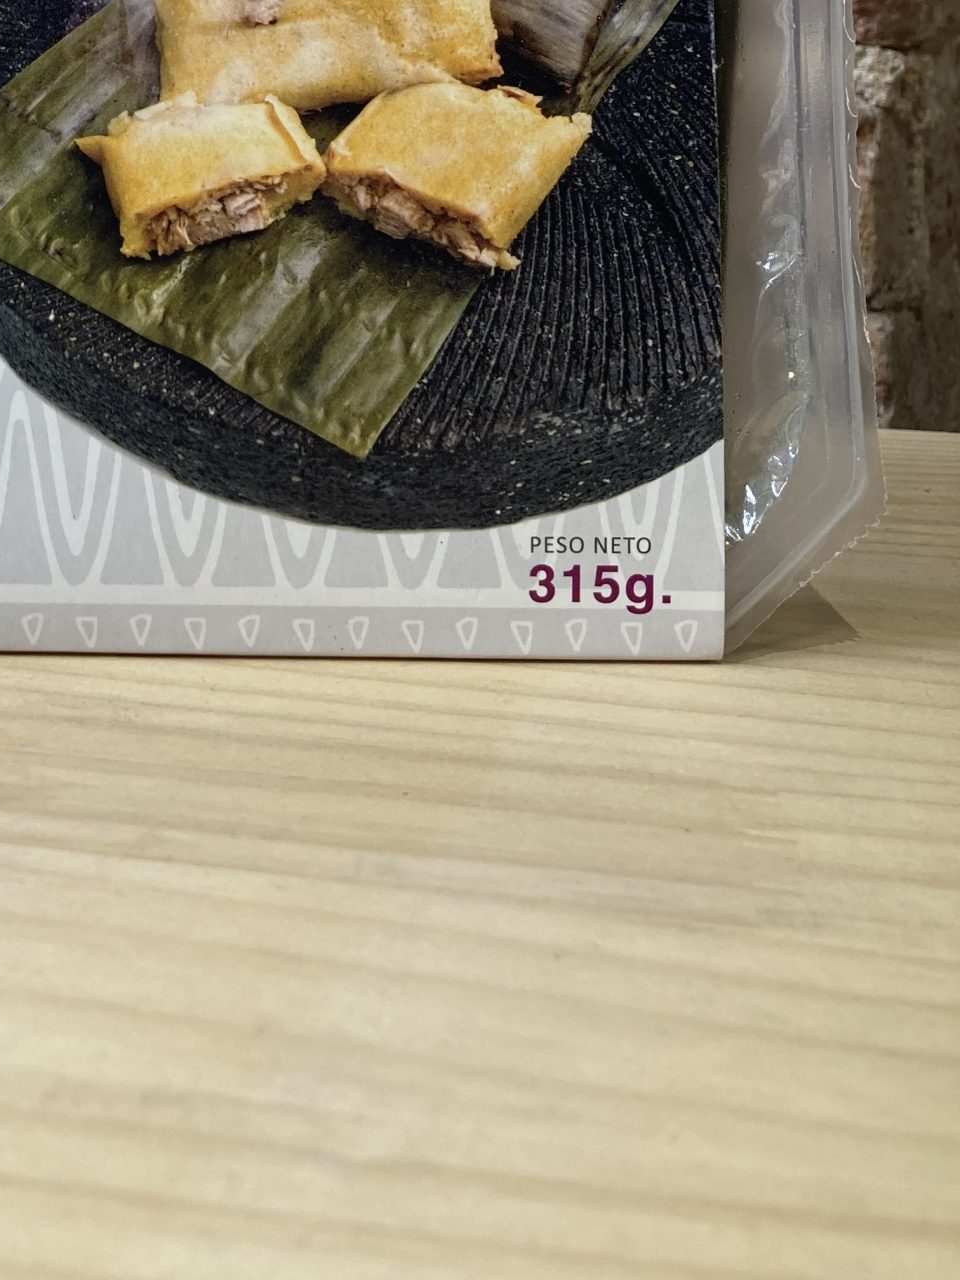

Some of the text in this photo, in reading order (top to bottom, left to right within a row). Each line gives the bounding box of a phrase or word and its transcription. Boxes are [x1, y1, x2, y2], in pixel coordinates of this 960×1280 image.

[530, 536, 652, 554] PESO NETO
[528, 563, 672, 615] 315g.
